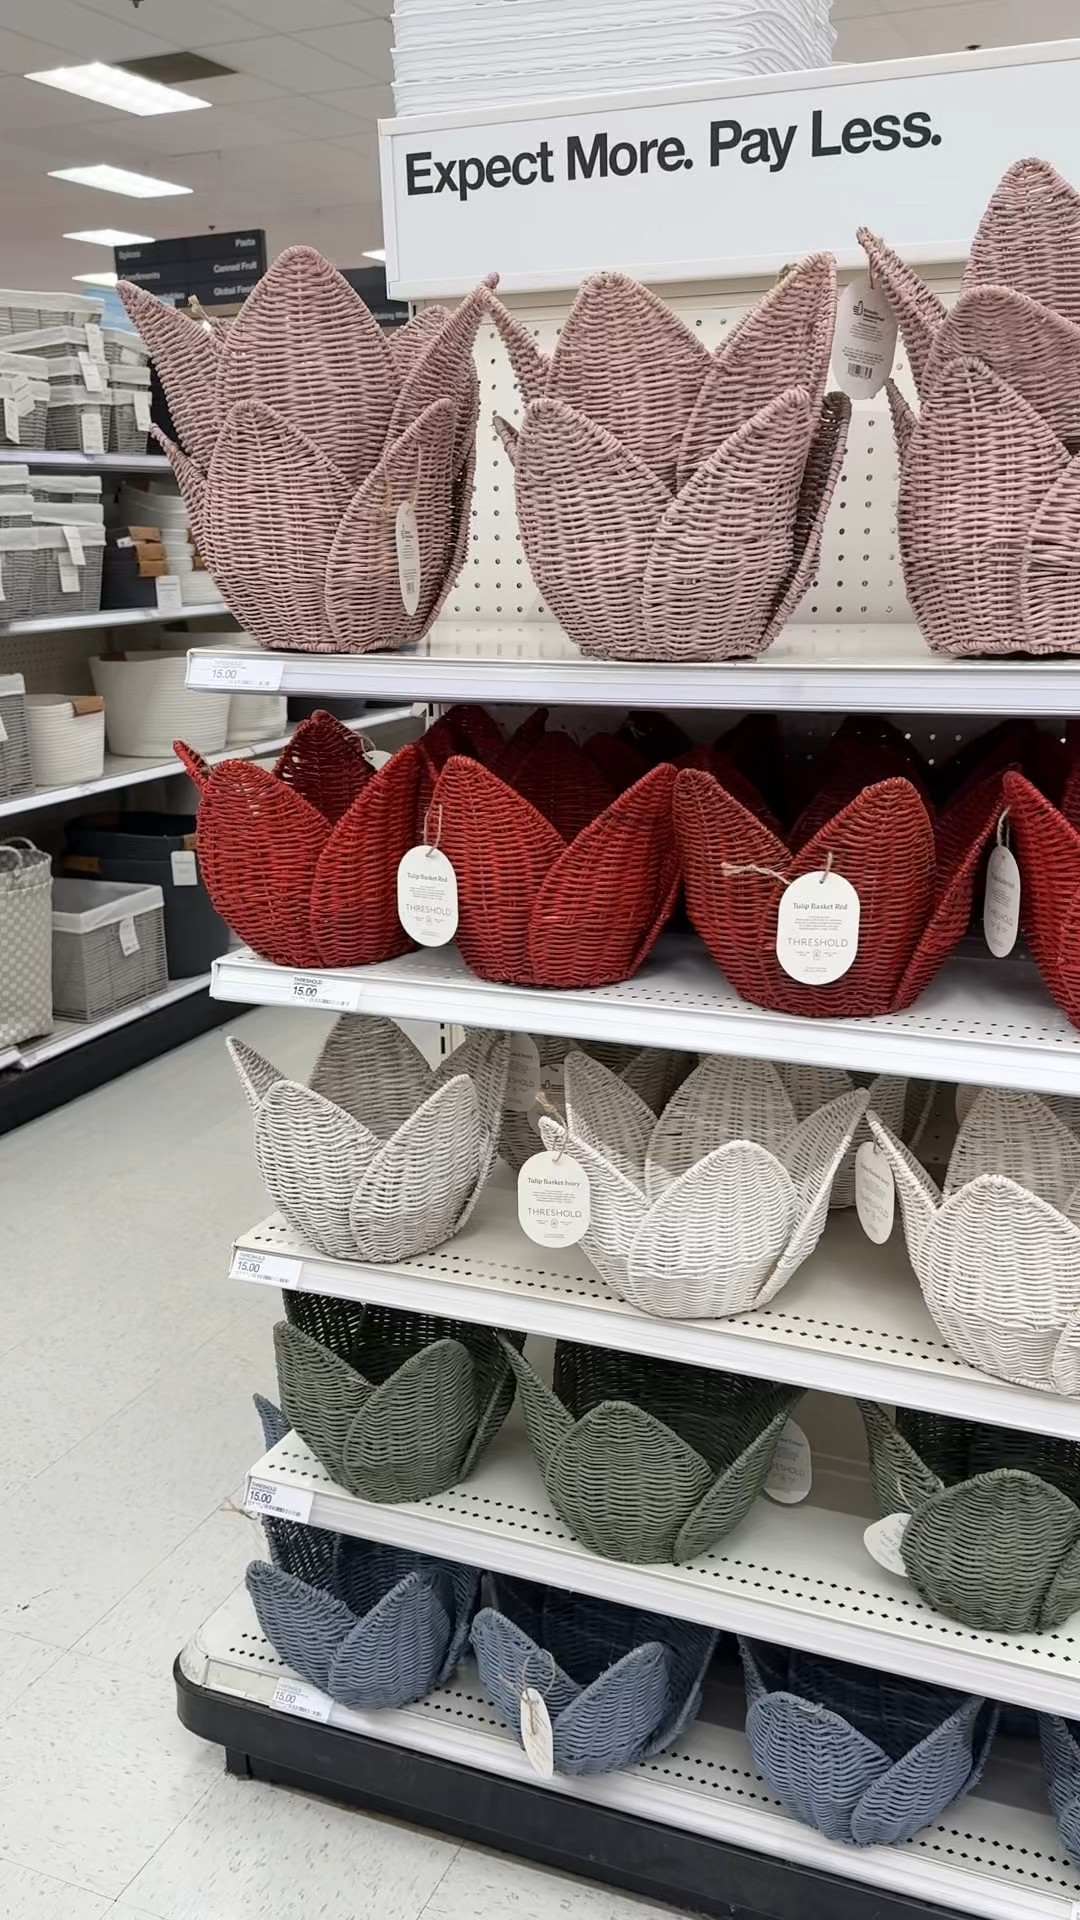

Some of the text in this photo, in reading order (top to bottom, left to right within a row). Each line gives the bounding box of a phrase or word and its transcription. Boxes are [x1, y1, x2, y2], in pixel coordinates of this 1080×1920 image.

[406, 110, 942, 201] Expect More. Pay Less.
[235, 238, 256, 247] Pasta
[213, 261, 257, 273] Canned Fruit
[212, 669, 237, 679] 15.00
[407, 872, 420, 881] Tulip
[406, 903, 452, 916] THRESHOLD
[793, 902, 809, 910] Tulip
[787, 938, 848, 948] THRESHOLD
[293, 986, 318, 997] 15.00
[543, 1178, 564, 1186] Basket
[527, 1207, 582, 1218] THRESHOLD
[238, 1261, 261, 1273] 15.00
[250, 1491, 272, 1504] 15.00
[275, 1691, 297, 1703] 15.00
